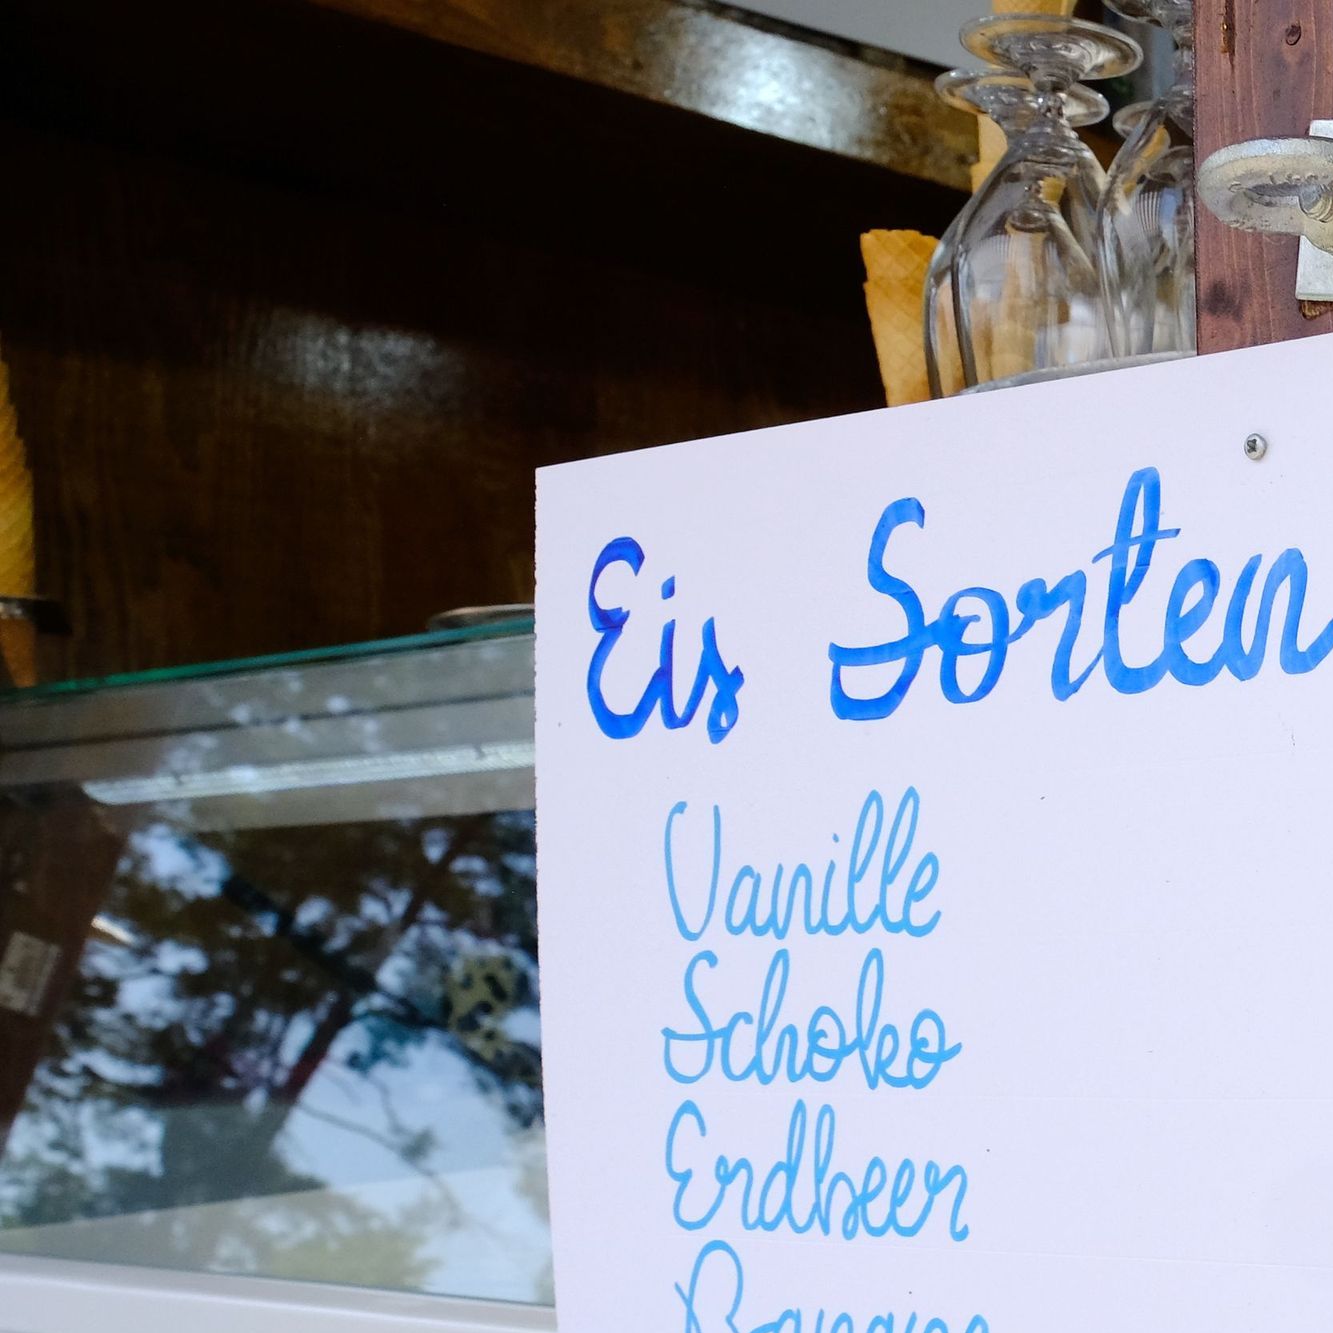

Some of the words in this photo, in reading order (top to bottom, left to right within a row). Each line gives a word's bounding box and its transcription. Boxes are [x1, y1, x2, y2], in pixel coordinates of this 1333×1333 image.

[586, 535, 746, 746] Eis
[663, 785, 942, 942] Vanille
[661, 947, 963, 1091] Schoko
[665, 1099, 970, 1243] Erdbeer
